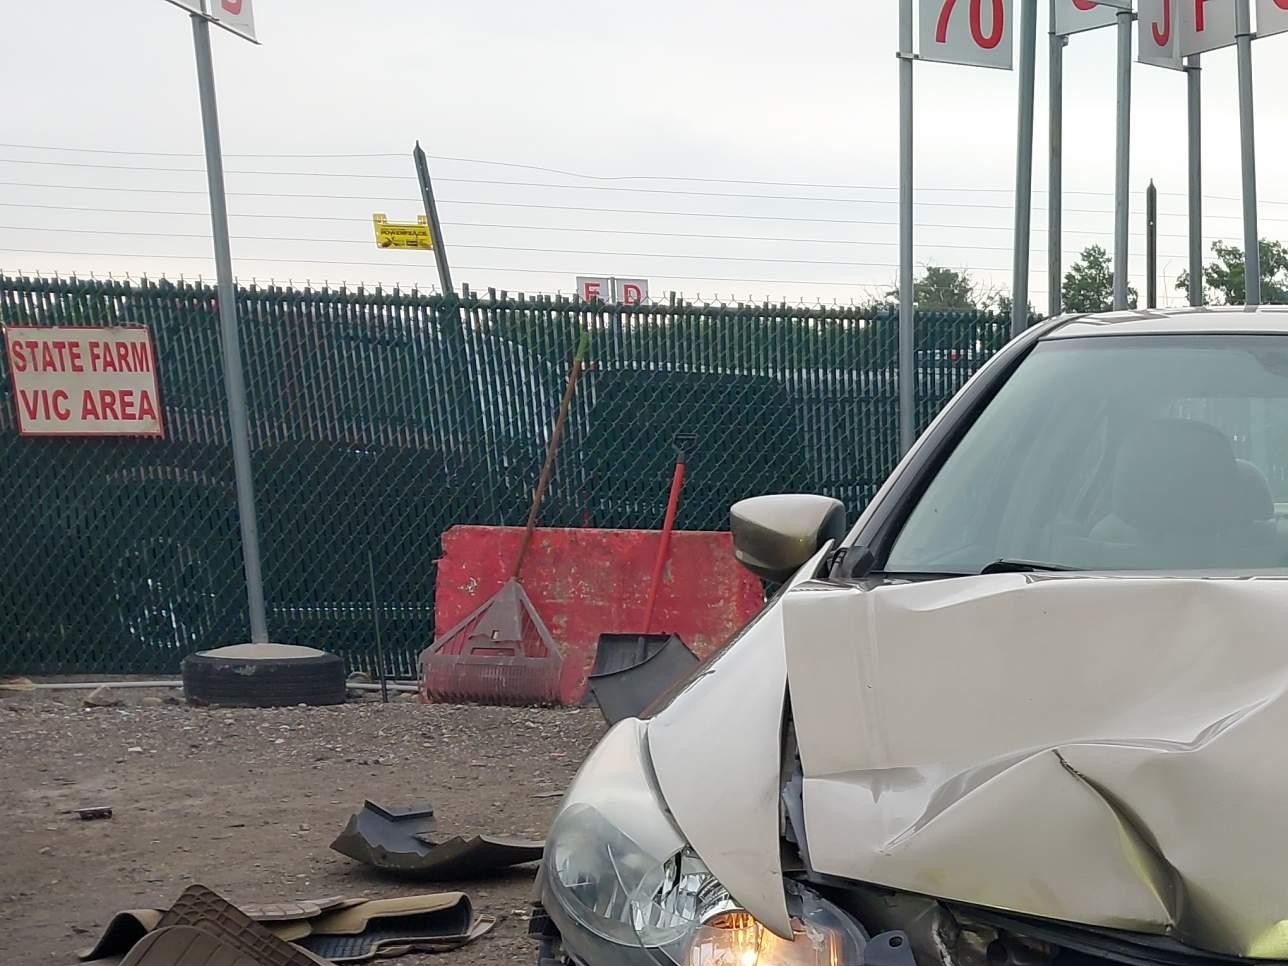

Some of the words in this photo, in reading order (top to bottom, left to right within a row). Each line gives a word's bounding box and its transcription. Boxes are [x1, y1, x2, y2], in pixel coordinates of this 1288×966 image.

[623, 284, 642, 306] D
[12, 340, 84, 373] STATE
[89, 341, 150, 373] FARM
[19, 389, 71, 421] VIC
[81, 389, 156, 421] AREA
